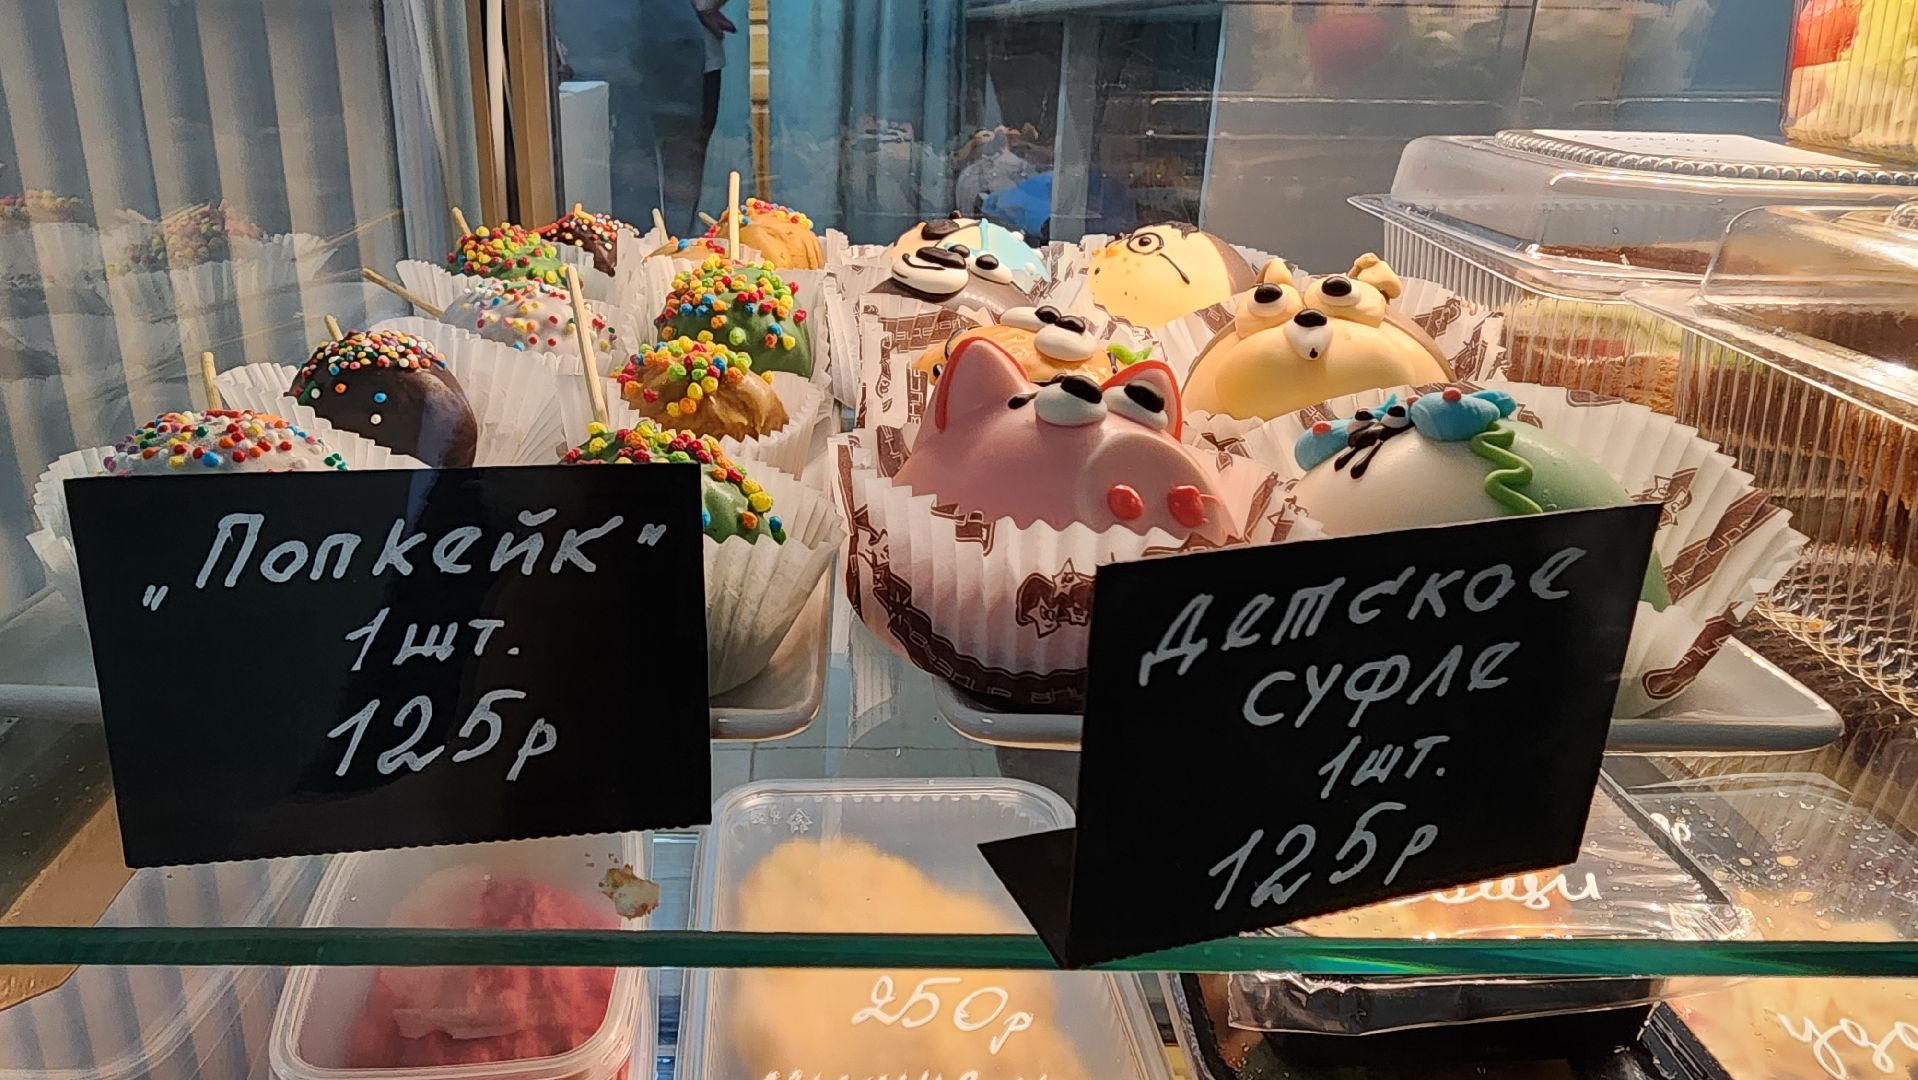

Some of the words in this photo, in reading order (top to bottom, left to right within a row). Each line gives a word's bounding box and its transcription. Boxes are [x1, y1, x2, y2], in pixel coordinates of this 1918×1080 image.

[345, 607, 391, 671] 1
[392, 618, 521, 666] шт.
[1138, 546, 1588, 686] Детское
[327, 688, 557, 782] 125р
[1208, 801, 1439, 910] 125р
[851, 975, 1034, 1056] 250р
